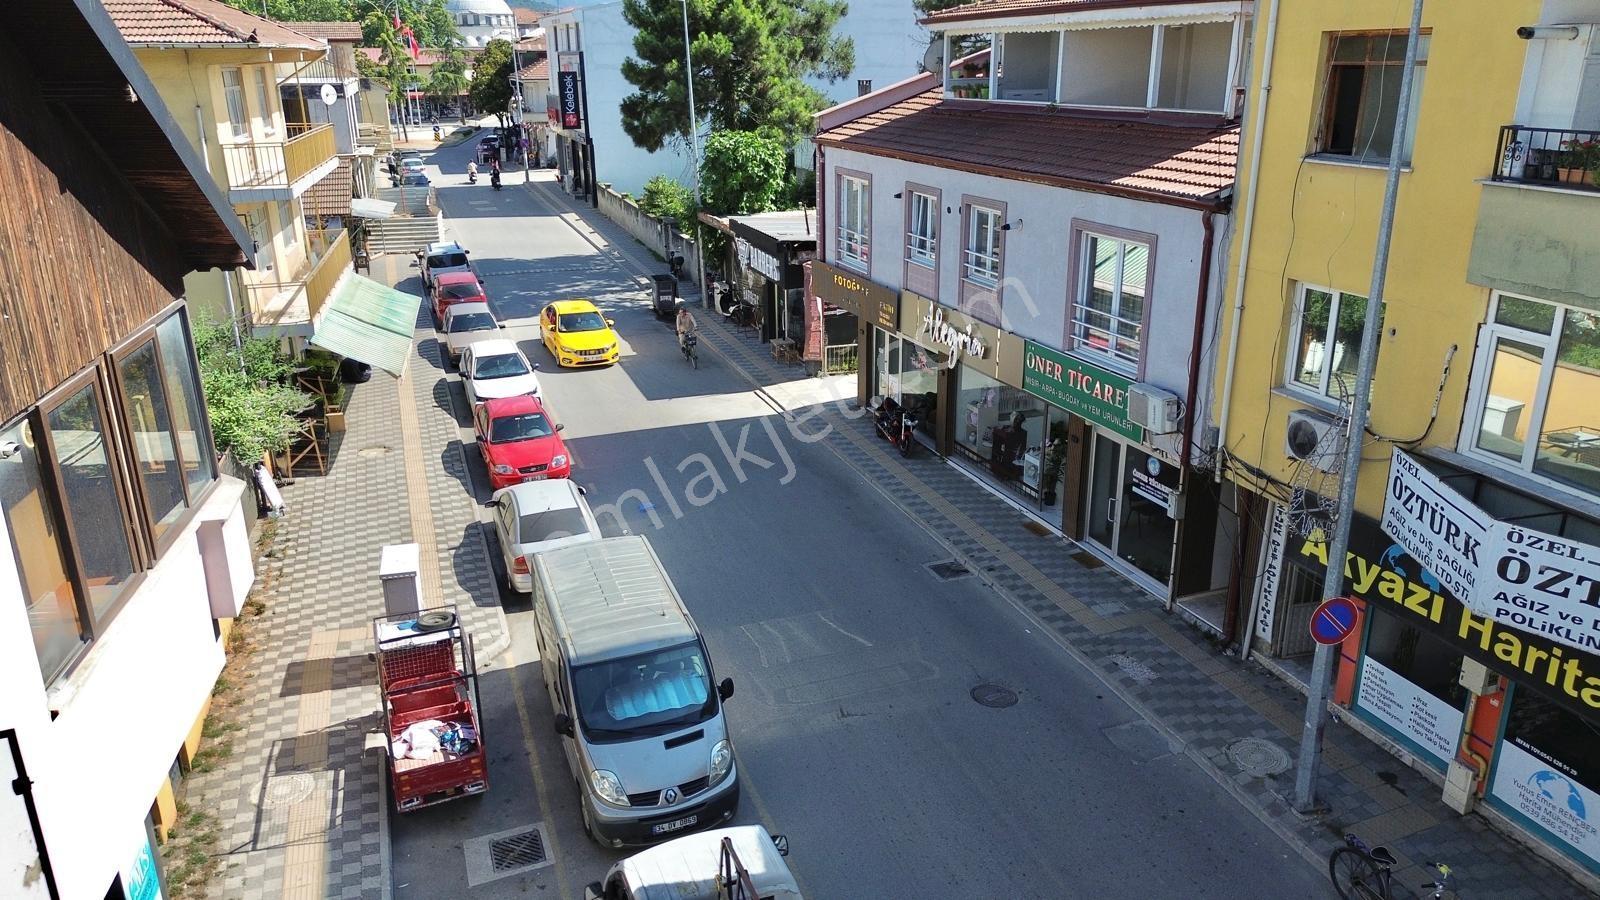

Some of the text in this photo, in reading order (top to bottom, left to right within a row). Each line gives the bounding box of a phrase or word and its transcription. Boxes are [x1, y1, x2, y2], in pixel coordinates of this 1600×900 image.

[564, 75, 576, 114] Kelebek
[921, 300, 985, 370] Alegria
[1026, 346, 1128, 411] ÖNER TİCARE
[1396, 450, 1422, 482] ÖZEL
[1392, 470, 1481, 568] ÖZTÜRK
[1390, 506, 1406, 530] AĞIZ
[1407, 525, 1418, 537] ve
[1436, 548, 1476, 588] SAĞLIĞI
[1506, 528, 1585, 562] ÖZEL
[1493, 592, 1584, 625] AĞIZ ve
[1458, 606, 1600, 708] Harita
[1415, 704, 1424, 713] Kot
[1514, 778, 1597, 834] Yunus Emre RENÇBER
[1518, 792, 1542, 812] Harita
